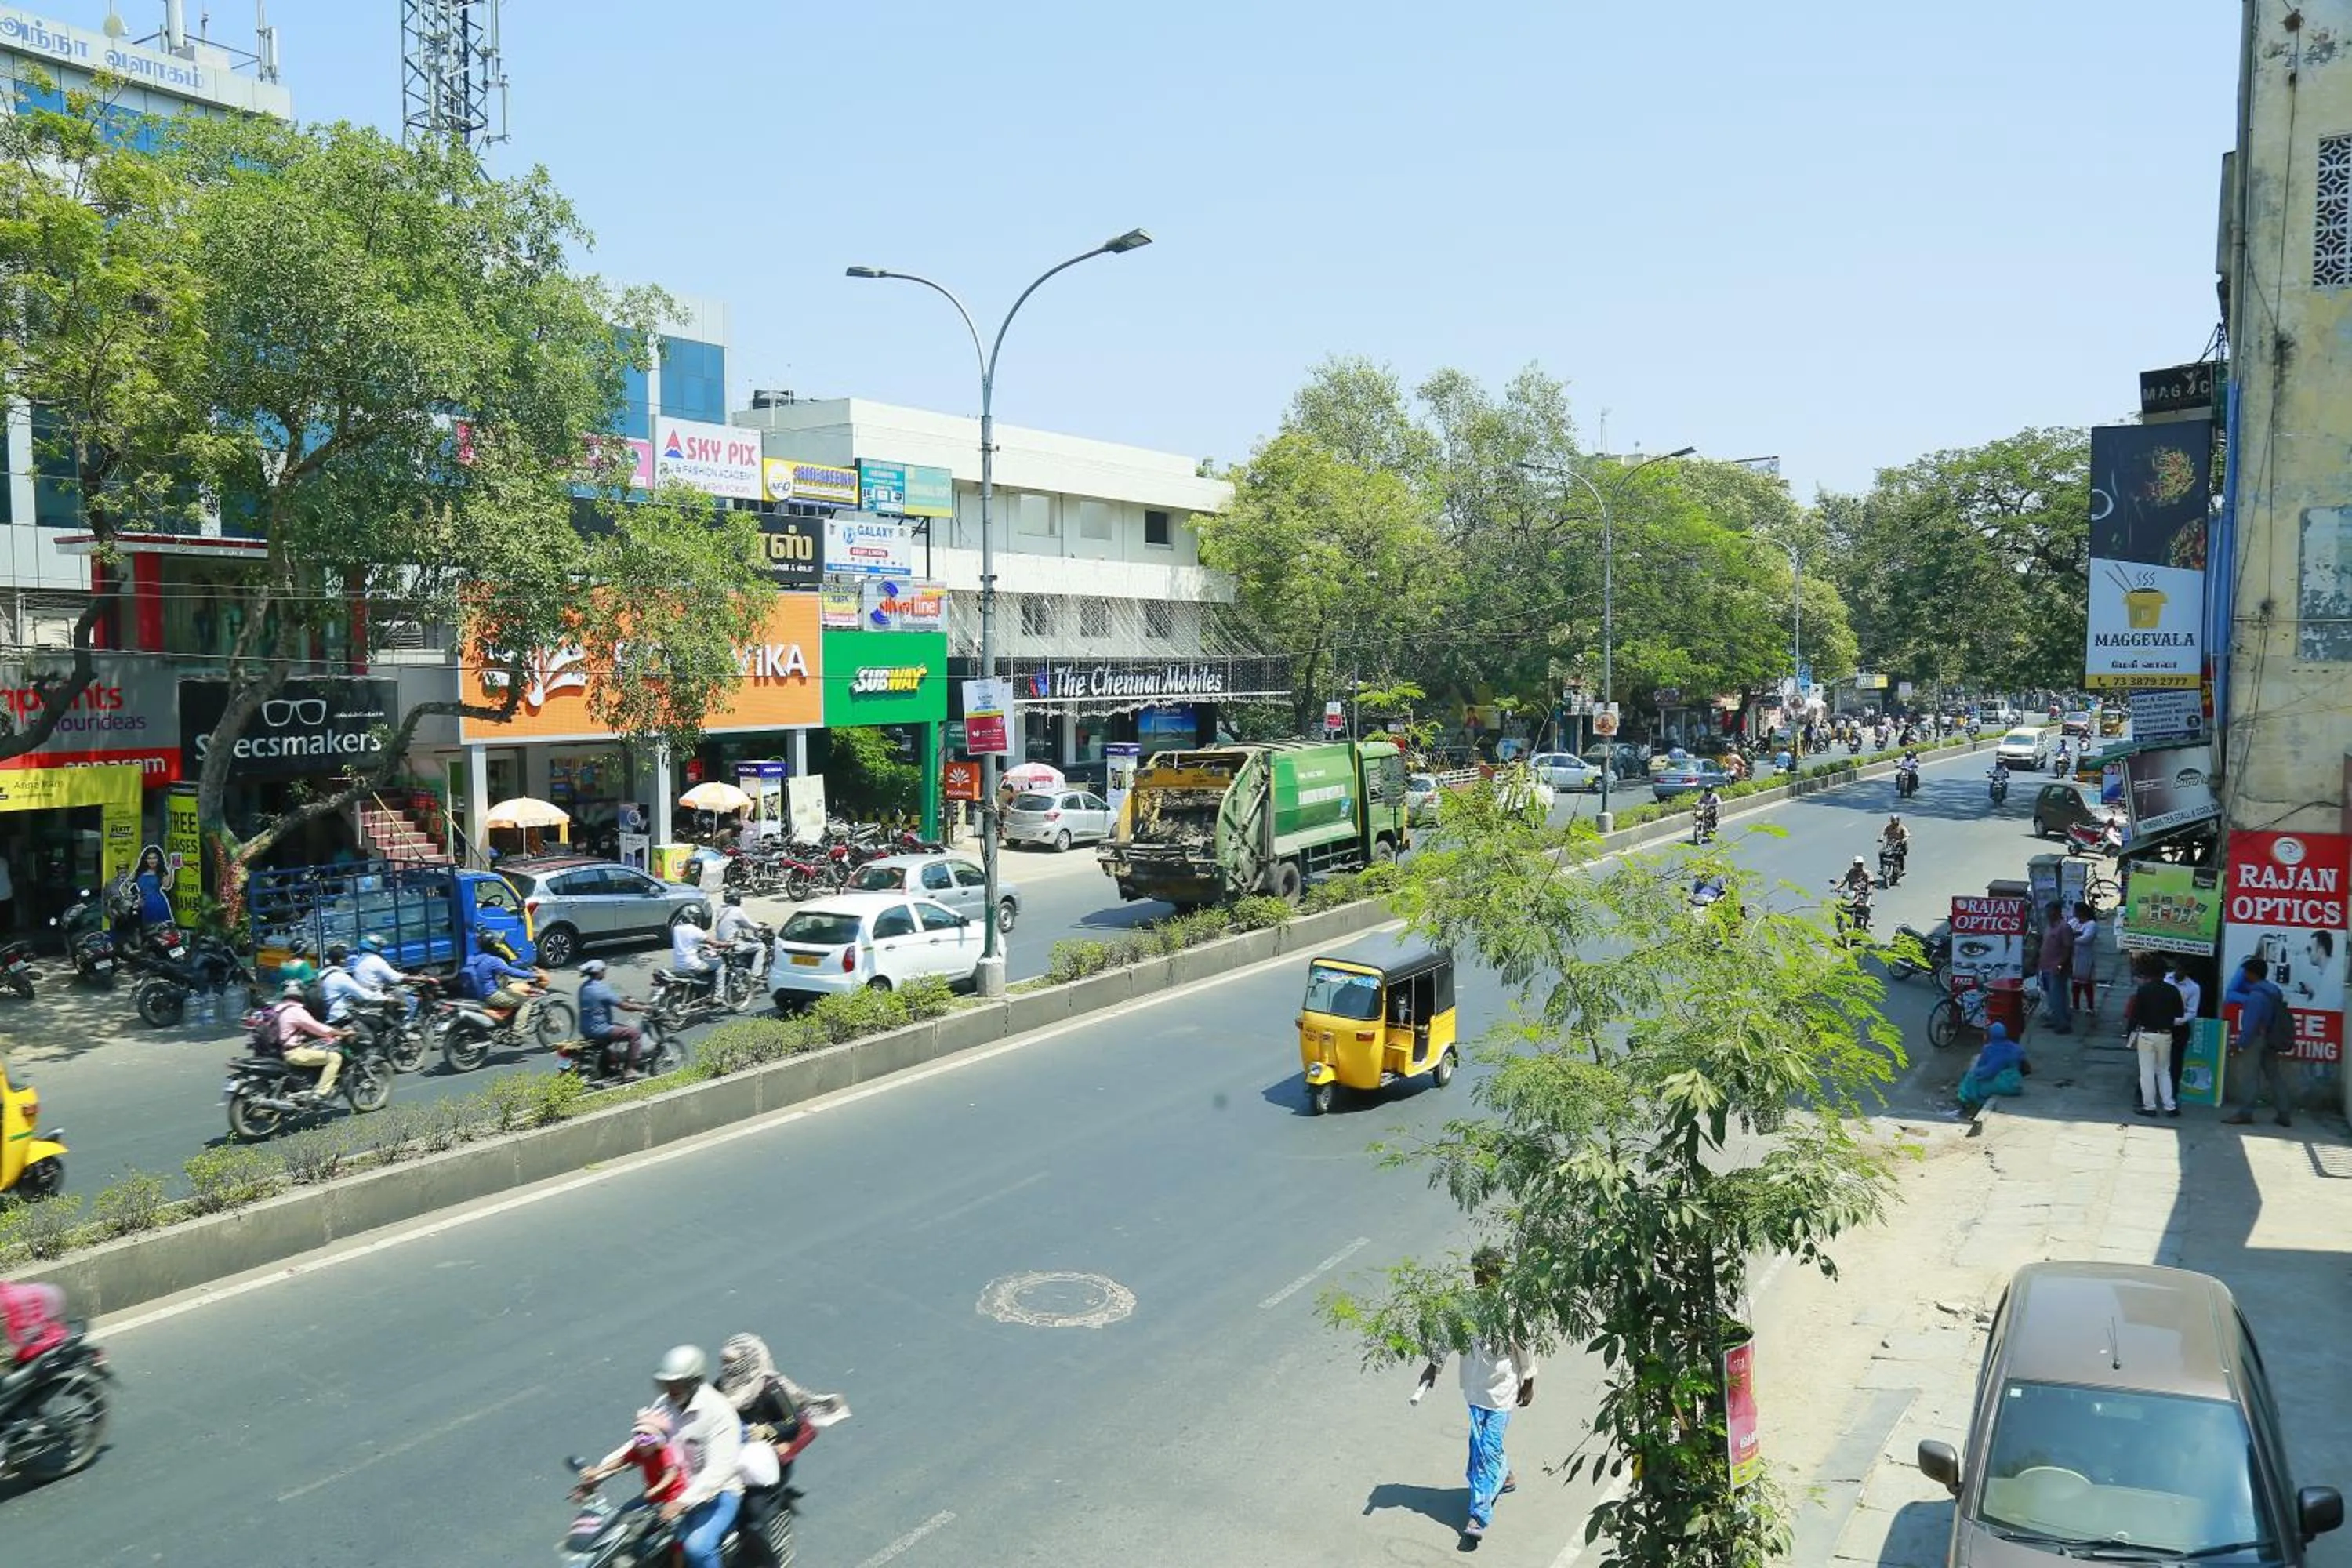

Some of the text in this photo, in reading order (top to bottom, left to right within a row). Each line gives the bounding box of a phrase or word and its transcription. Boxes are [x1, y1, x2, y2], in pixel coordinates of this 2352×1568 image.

[686, 436, 756, 466] SKY PIX
[857, 524, 894, 538] GALAXY
[2095, 633, 2196, 647] MAGGEVALA
[853, 664, 927, 693] SUBWAY
[1055, 666, 1222, 696] The Chennai Mobiles
[2113, 677, 2126, 686] 73
[195, 729, 382, 761] Secsmakers
[170, 812, 197, 834] REE
[2238, 863, 2339, 892] RAJAN
[1968, 899, 2020, 916] RAJAN
[2232, 896, 2342, 925] OPTICS
[1955, 915, 2020, 931] OPTICS
